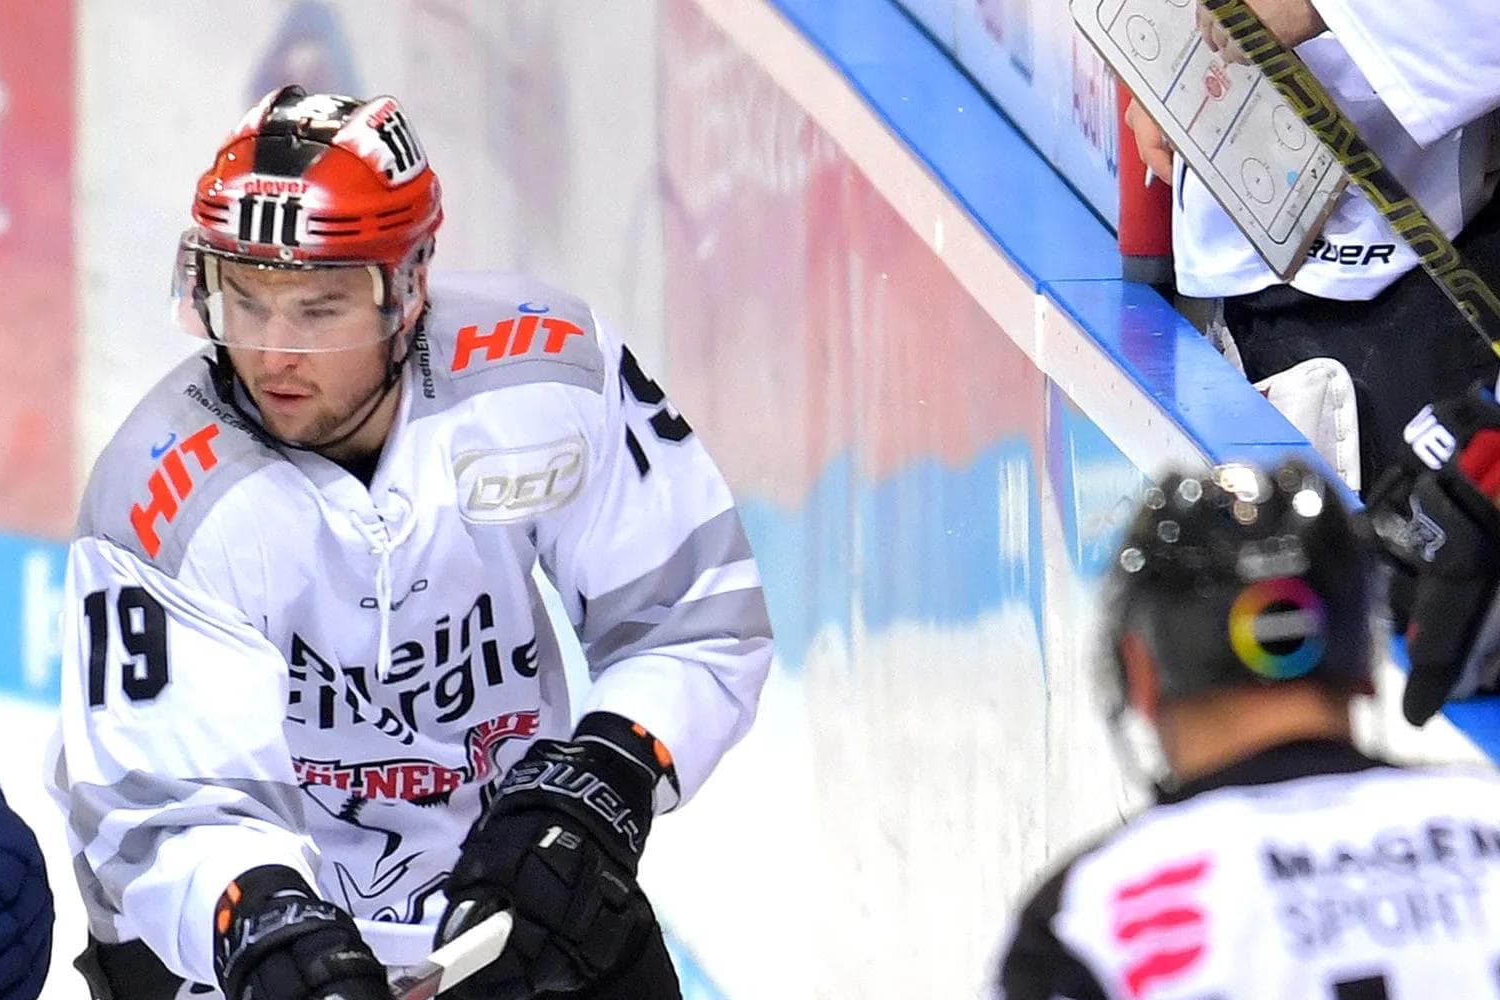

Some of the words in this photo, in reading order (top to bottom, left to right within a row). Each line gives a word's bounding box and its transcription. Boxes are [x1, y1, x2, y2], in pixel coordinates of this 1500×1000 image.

[451, 303, 585, 372] HIT
[130, 423, 220, 559] HIT
[83, 585, 173, 709] 19
